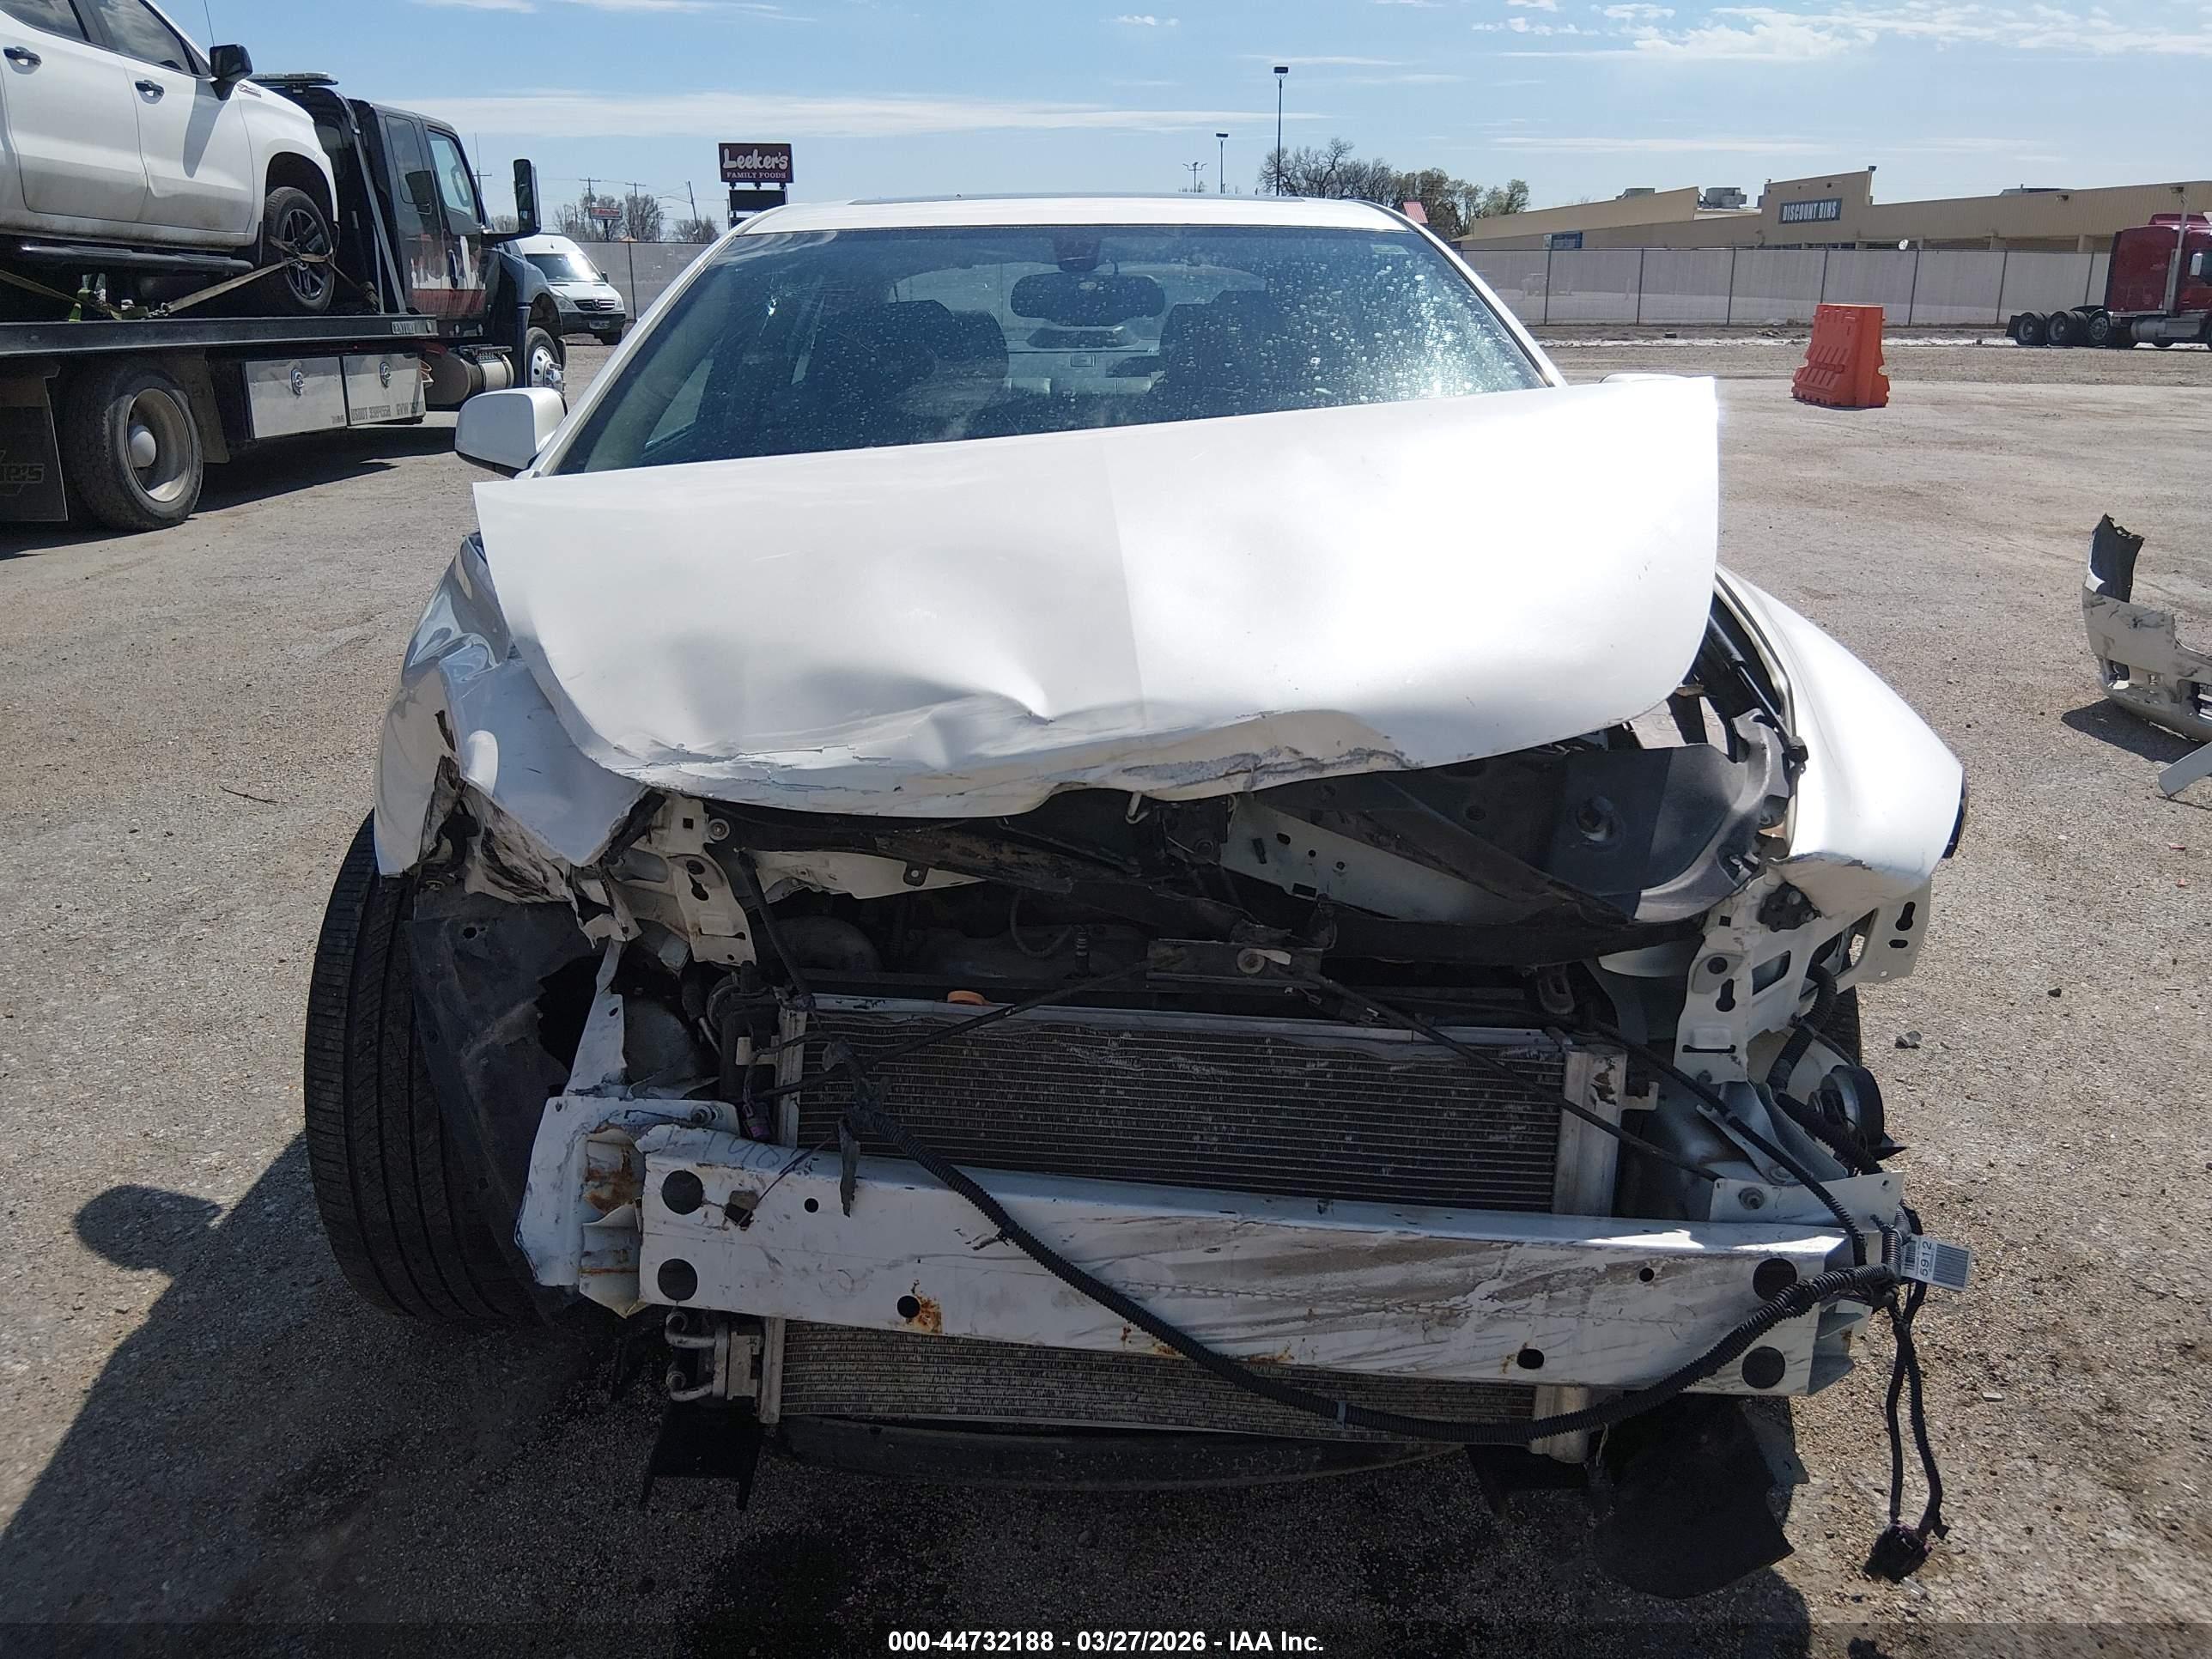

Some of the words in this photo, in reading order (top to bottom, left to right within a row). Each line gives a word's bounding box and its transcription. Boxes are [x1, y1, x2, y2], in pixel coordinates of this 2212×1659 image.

[723, 149, 788, 169] Leeker's
[1783, 204, 1818, 221] DISCOUNT
[1819, 201, 1837, 219] BINS
[1919, 1240, 1932, 1277] 5912
